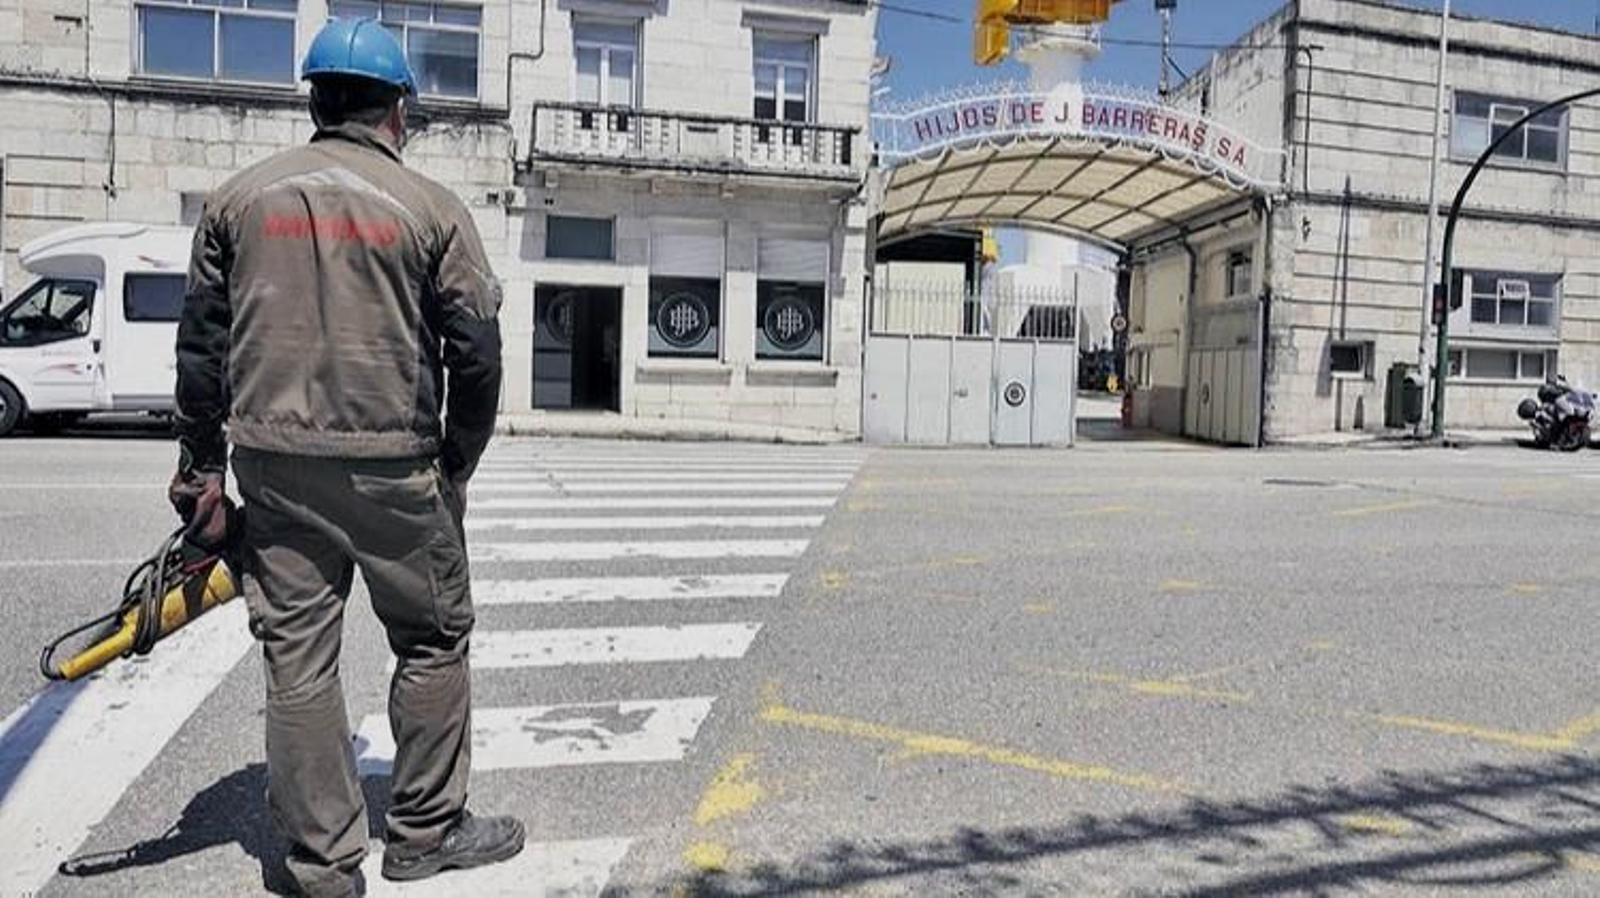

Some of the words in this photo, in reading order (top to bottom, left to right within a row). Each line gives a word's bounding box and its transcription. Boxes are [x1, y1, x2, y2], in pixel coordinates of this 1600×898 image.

[914, 105, 997, 141] HIJOS
[1011, 101, 1044, 123] DE
[1082, 103, 1207, 148] BARRERAS
